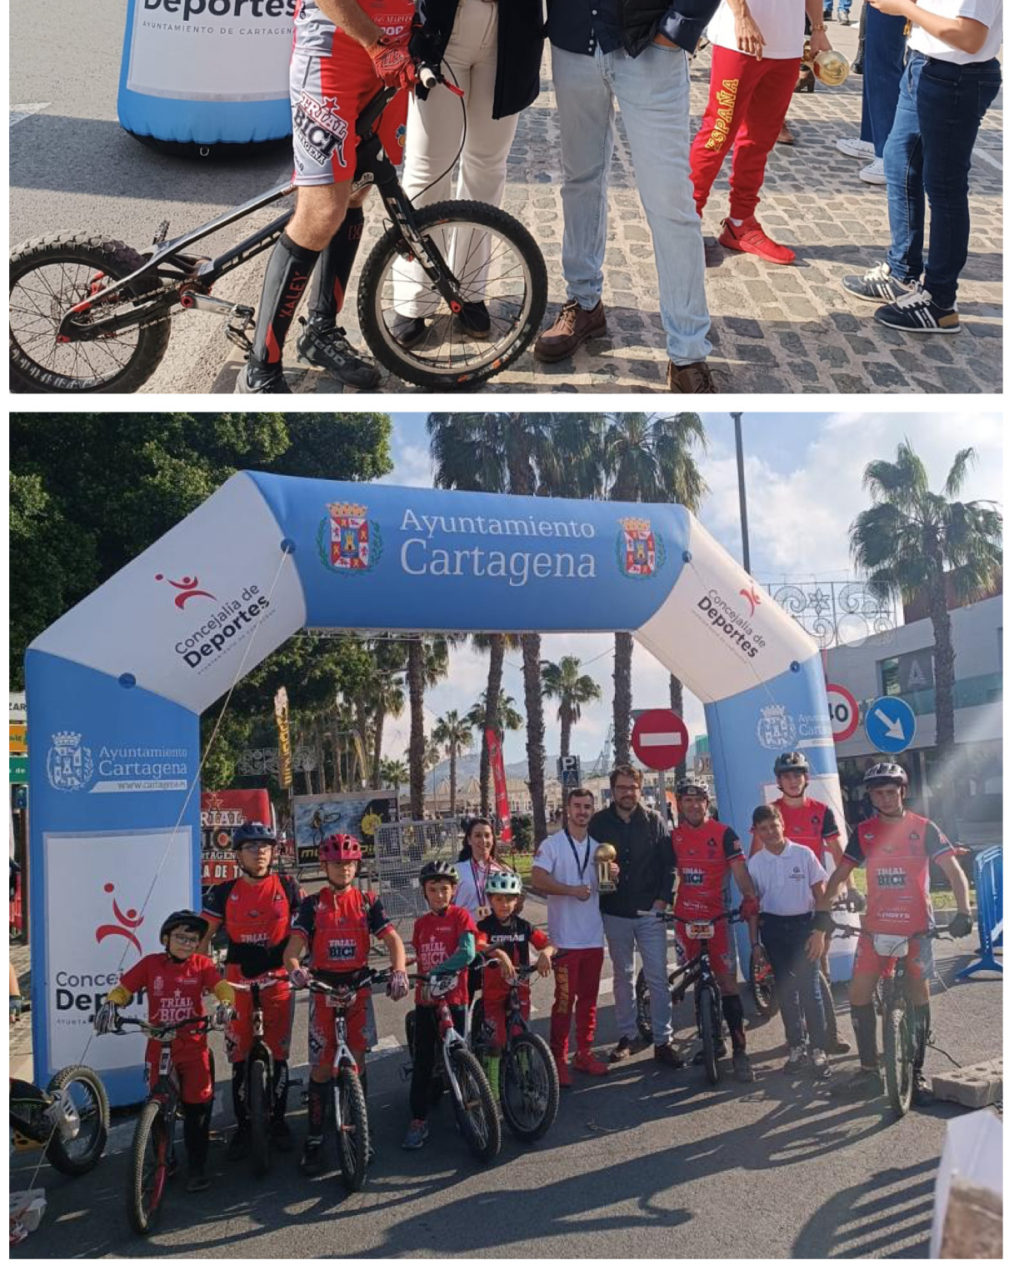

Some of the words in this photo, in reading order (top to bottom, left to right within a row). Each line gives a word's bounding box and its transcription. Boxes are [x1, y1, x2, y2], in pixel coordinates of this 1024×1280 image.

[142, 20, 214, 35] AYUNTAMIENTO
[220, 27, 233, 35] DE
[239, 27, 296, 36] CARTAGEN
[301, 91, 349, 138] TRIAL
[704, 78, 739, 152] ESPAÑA
[293, 108, 343, 160] BICI
[400, 508, 596, 539] Ayuntamiento
[399, 538, 598, 587] Cartagena
[174, 600, 242, 655] Concejalía
[241, 584, 260, 602] de
[696, 595, 758, 658] Deportes
[707, 588, 753, 636] Concejalía
[752, 634, 766, 648] de
[183, 595, 270, 669] Deportes
[98, 746, 188, 761] Ayuntamiento
[98, 760, 188, 780] Cartagena
[201, 810, 245, 827] RIAL
[878, 874, 906, 886] BICI
[329, 939, 357, 948] TRIAL
[329, 946, 356, 957] BICI
[422, 942, 447, 952] TRIAL
[160, 997, 193, 1008] TRIAL
[160, 1008, 192, 1022] BICI
